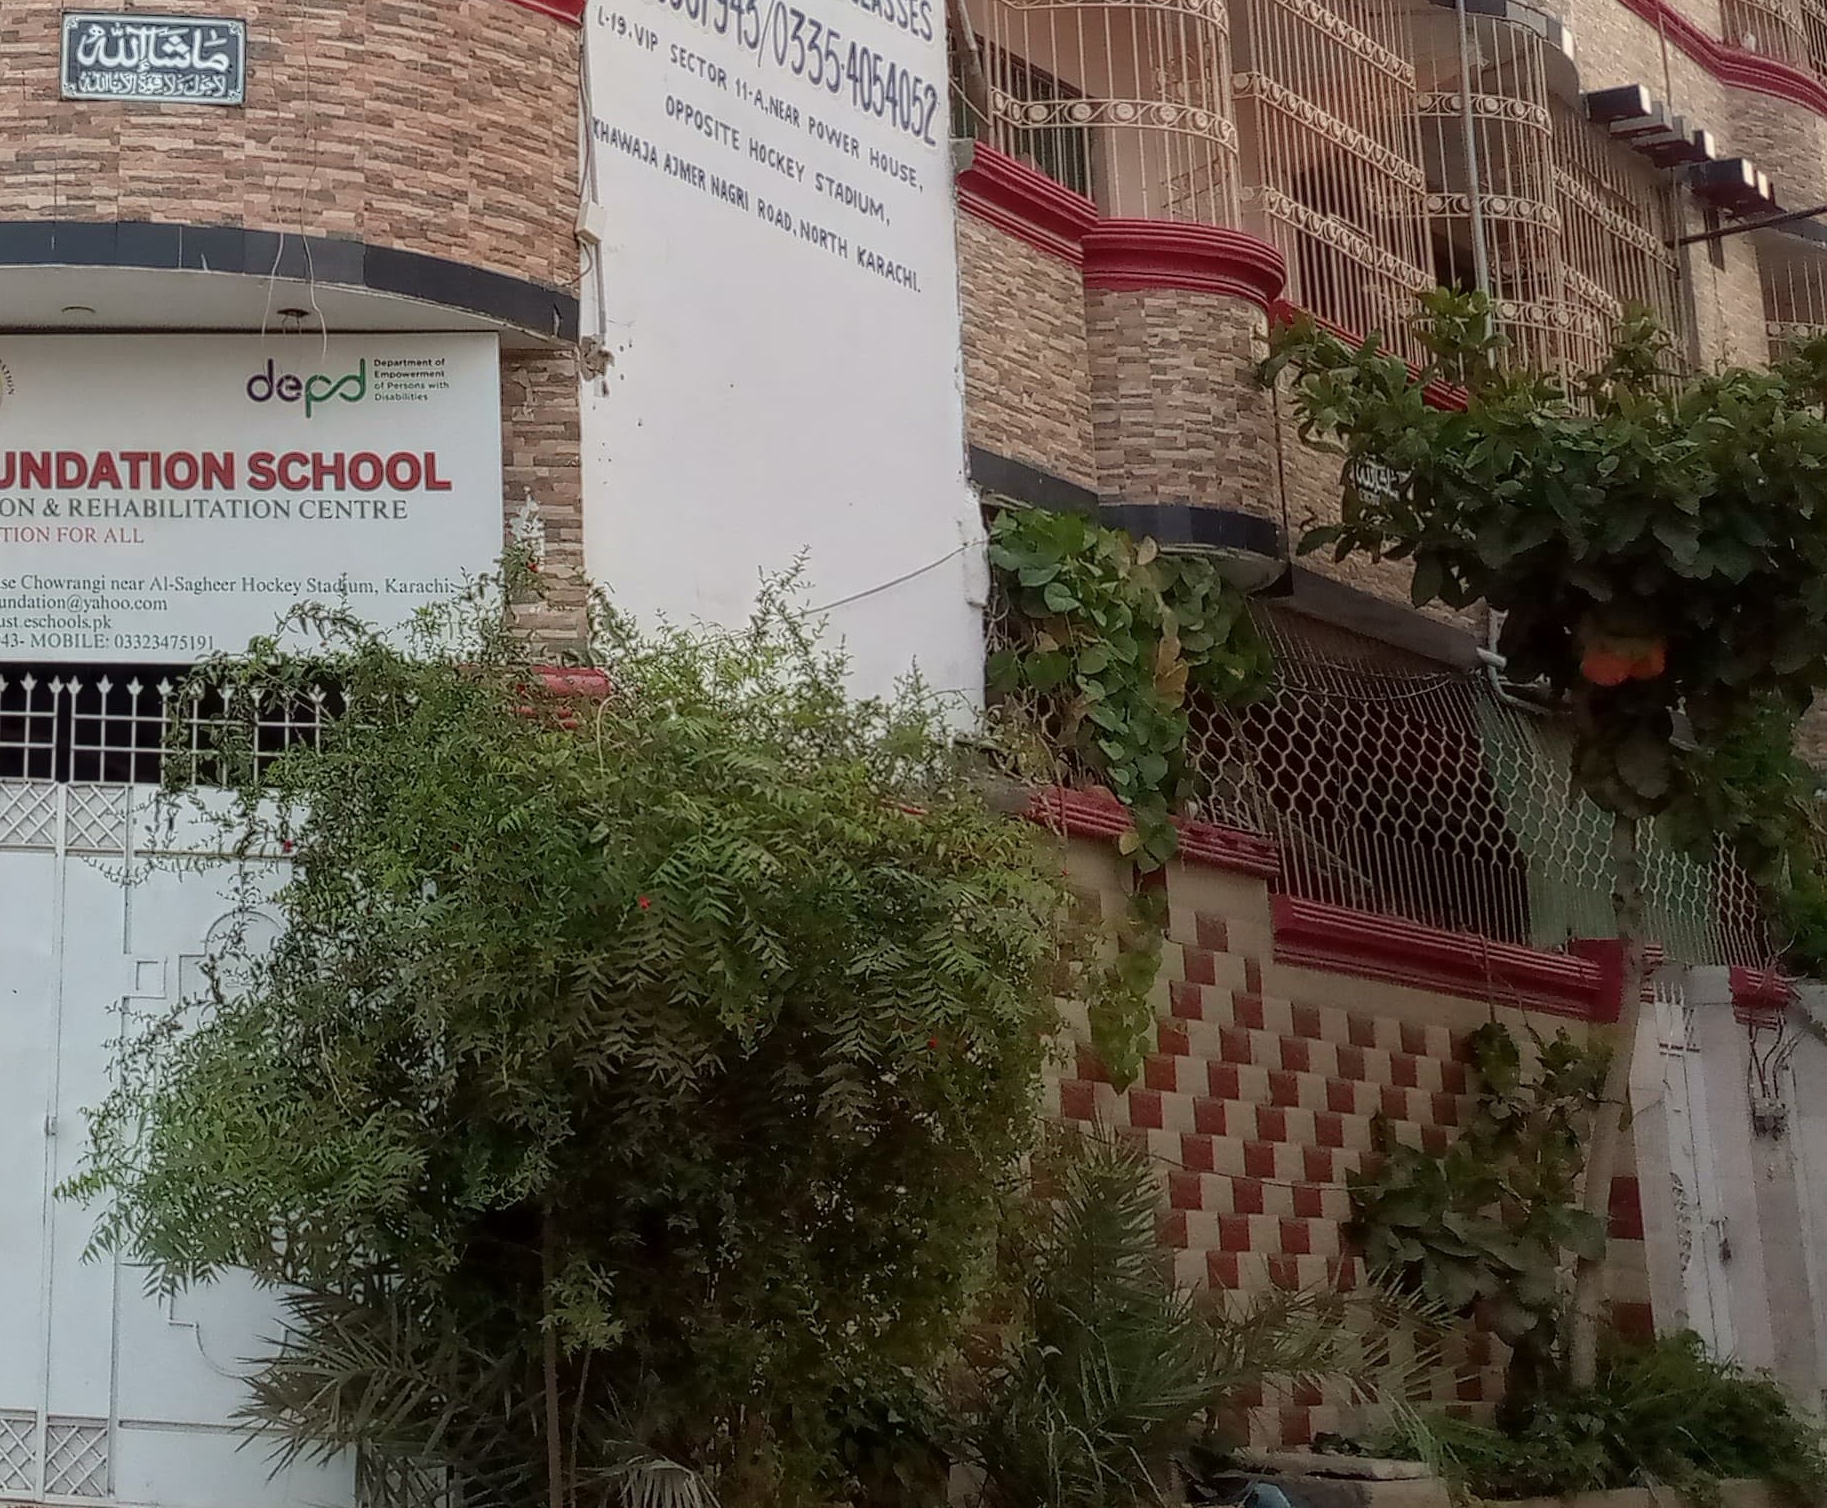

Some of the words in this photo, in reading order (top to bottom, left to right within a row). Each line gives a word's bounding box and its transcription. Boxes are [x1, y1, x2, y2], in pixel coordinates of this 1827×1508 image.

[670, 43, 728, 91] SECTOR
[808, 115, 860, 159] POWER
[665, 95, 741, 151] OPPOSITE
[749, 137, 805, 183] HOCKEY
[664, 153, 706, 192] AJMER
[711, 174, 749, 212] NAGRI
[799, 219, 848, 259] NORTH
[374, 358, 432, 369] Department
[434, 358, 445, 367] of
[374, 370, 445, 380] Empowerment
[374, 381, 385, 390] of
[387, 381, 426, 390] Persons
[428, 380, 450, 390] with
[247, 451, 452, 492] SCHOOL
[42, 499, 62, 519] &
[68, 499, 291, 520] REHABILITATION
[297, 499, 408, 520] CENTRE
[56, 527, 97, 544] FOR
[103, 527, 145, 544] ALL
[20, 575, 107, 595] Chowrangi
[111, 579, 145, 592] near
[149, 576, 237, 596] Al-Sagheer
[241, 576, 302, 596] Hockey
[29, 633, 110, 649] MOBILE:
[114, 634, 215, 651] 03323475191
